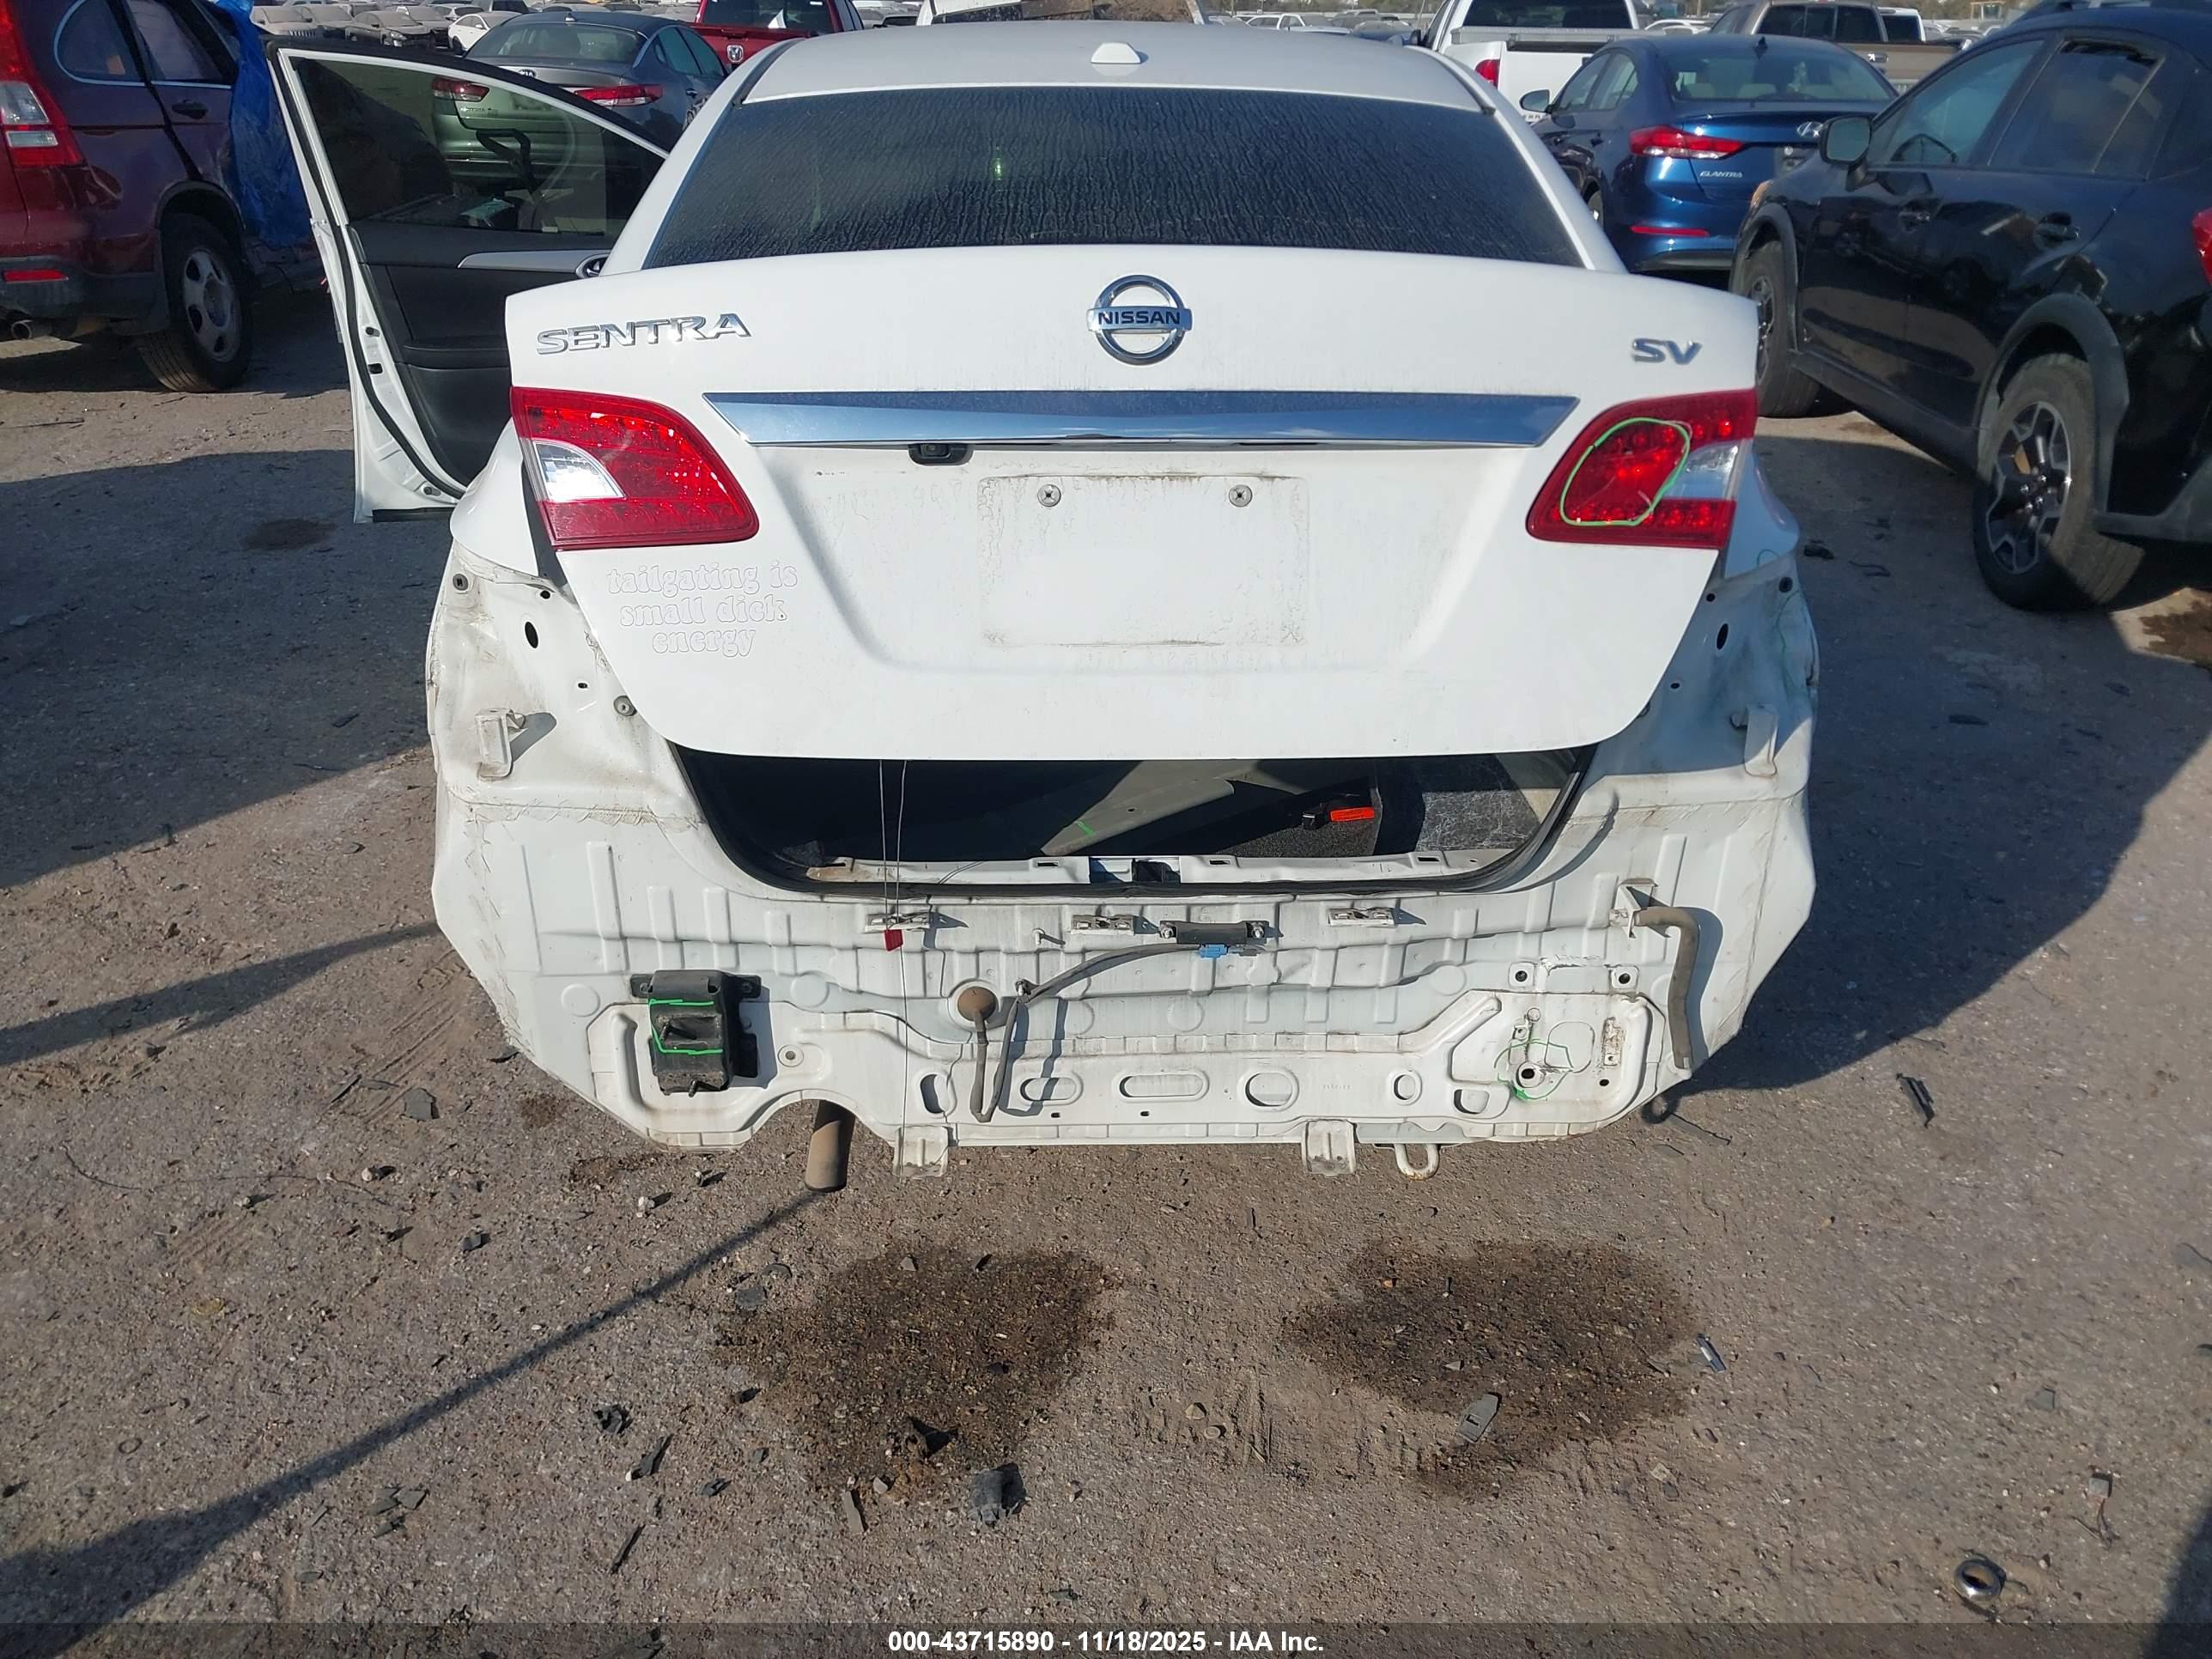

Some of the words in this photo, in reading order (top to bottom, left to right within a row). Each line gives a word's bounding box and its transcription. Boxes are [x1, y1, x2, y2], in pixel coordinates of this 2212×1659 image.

[1098, 311, 1181, 325] NISSAN
[536, 313, 751, 356] SENTRA
[1632, 337, 1703, 365] SV
[606, 562, 761, 598] tailgating
[769, 560, 799, 588] is
[620, 596, 707, 626] small
[716, 594, 787, 623] dick
[652, 629, 757, 658] energy
